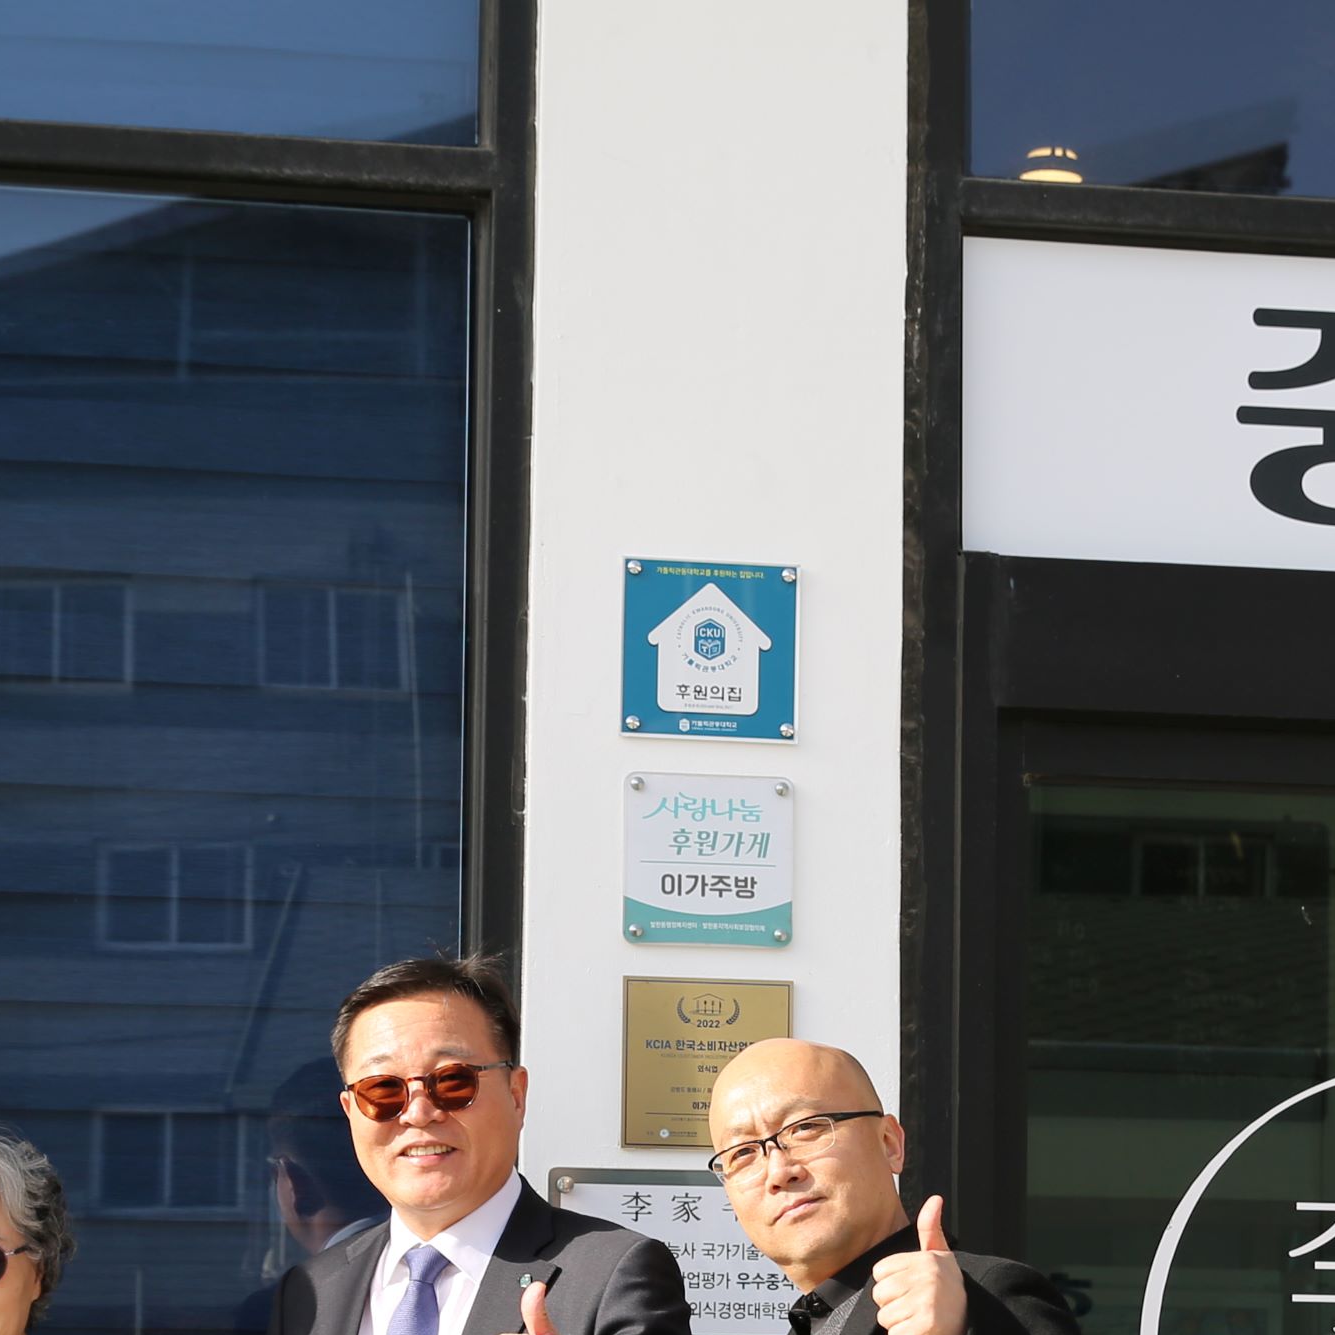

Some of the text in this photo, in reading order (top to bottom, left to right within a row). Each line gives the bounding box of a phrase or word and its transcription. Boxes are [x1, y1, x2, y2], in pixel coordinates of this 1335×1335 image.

[699, 627, 721, 638] CKU
[675, 683, 742, 702] 후원의집
[642, 791, 764, 823] 사랑나눔
[668, 828, 771, 859] 후원가게
[661, 873, 758, 899] 이가주방
[696, 1019, 721, 1028] 2022
[645, 1039, 754, 1052] KCIA 한국소비자산업
[621, 1191, 653, 1222] 李
[671, 1192, 703, 1223] 家
[701, 1242, 766, 1261] 국가기술
[684, 1271, 800, 1291] 업평가 우수중식
